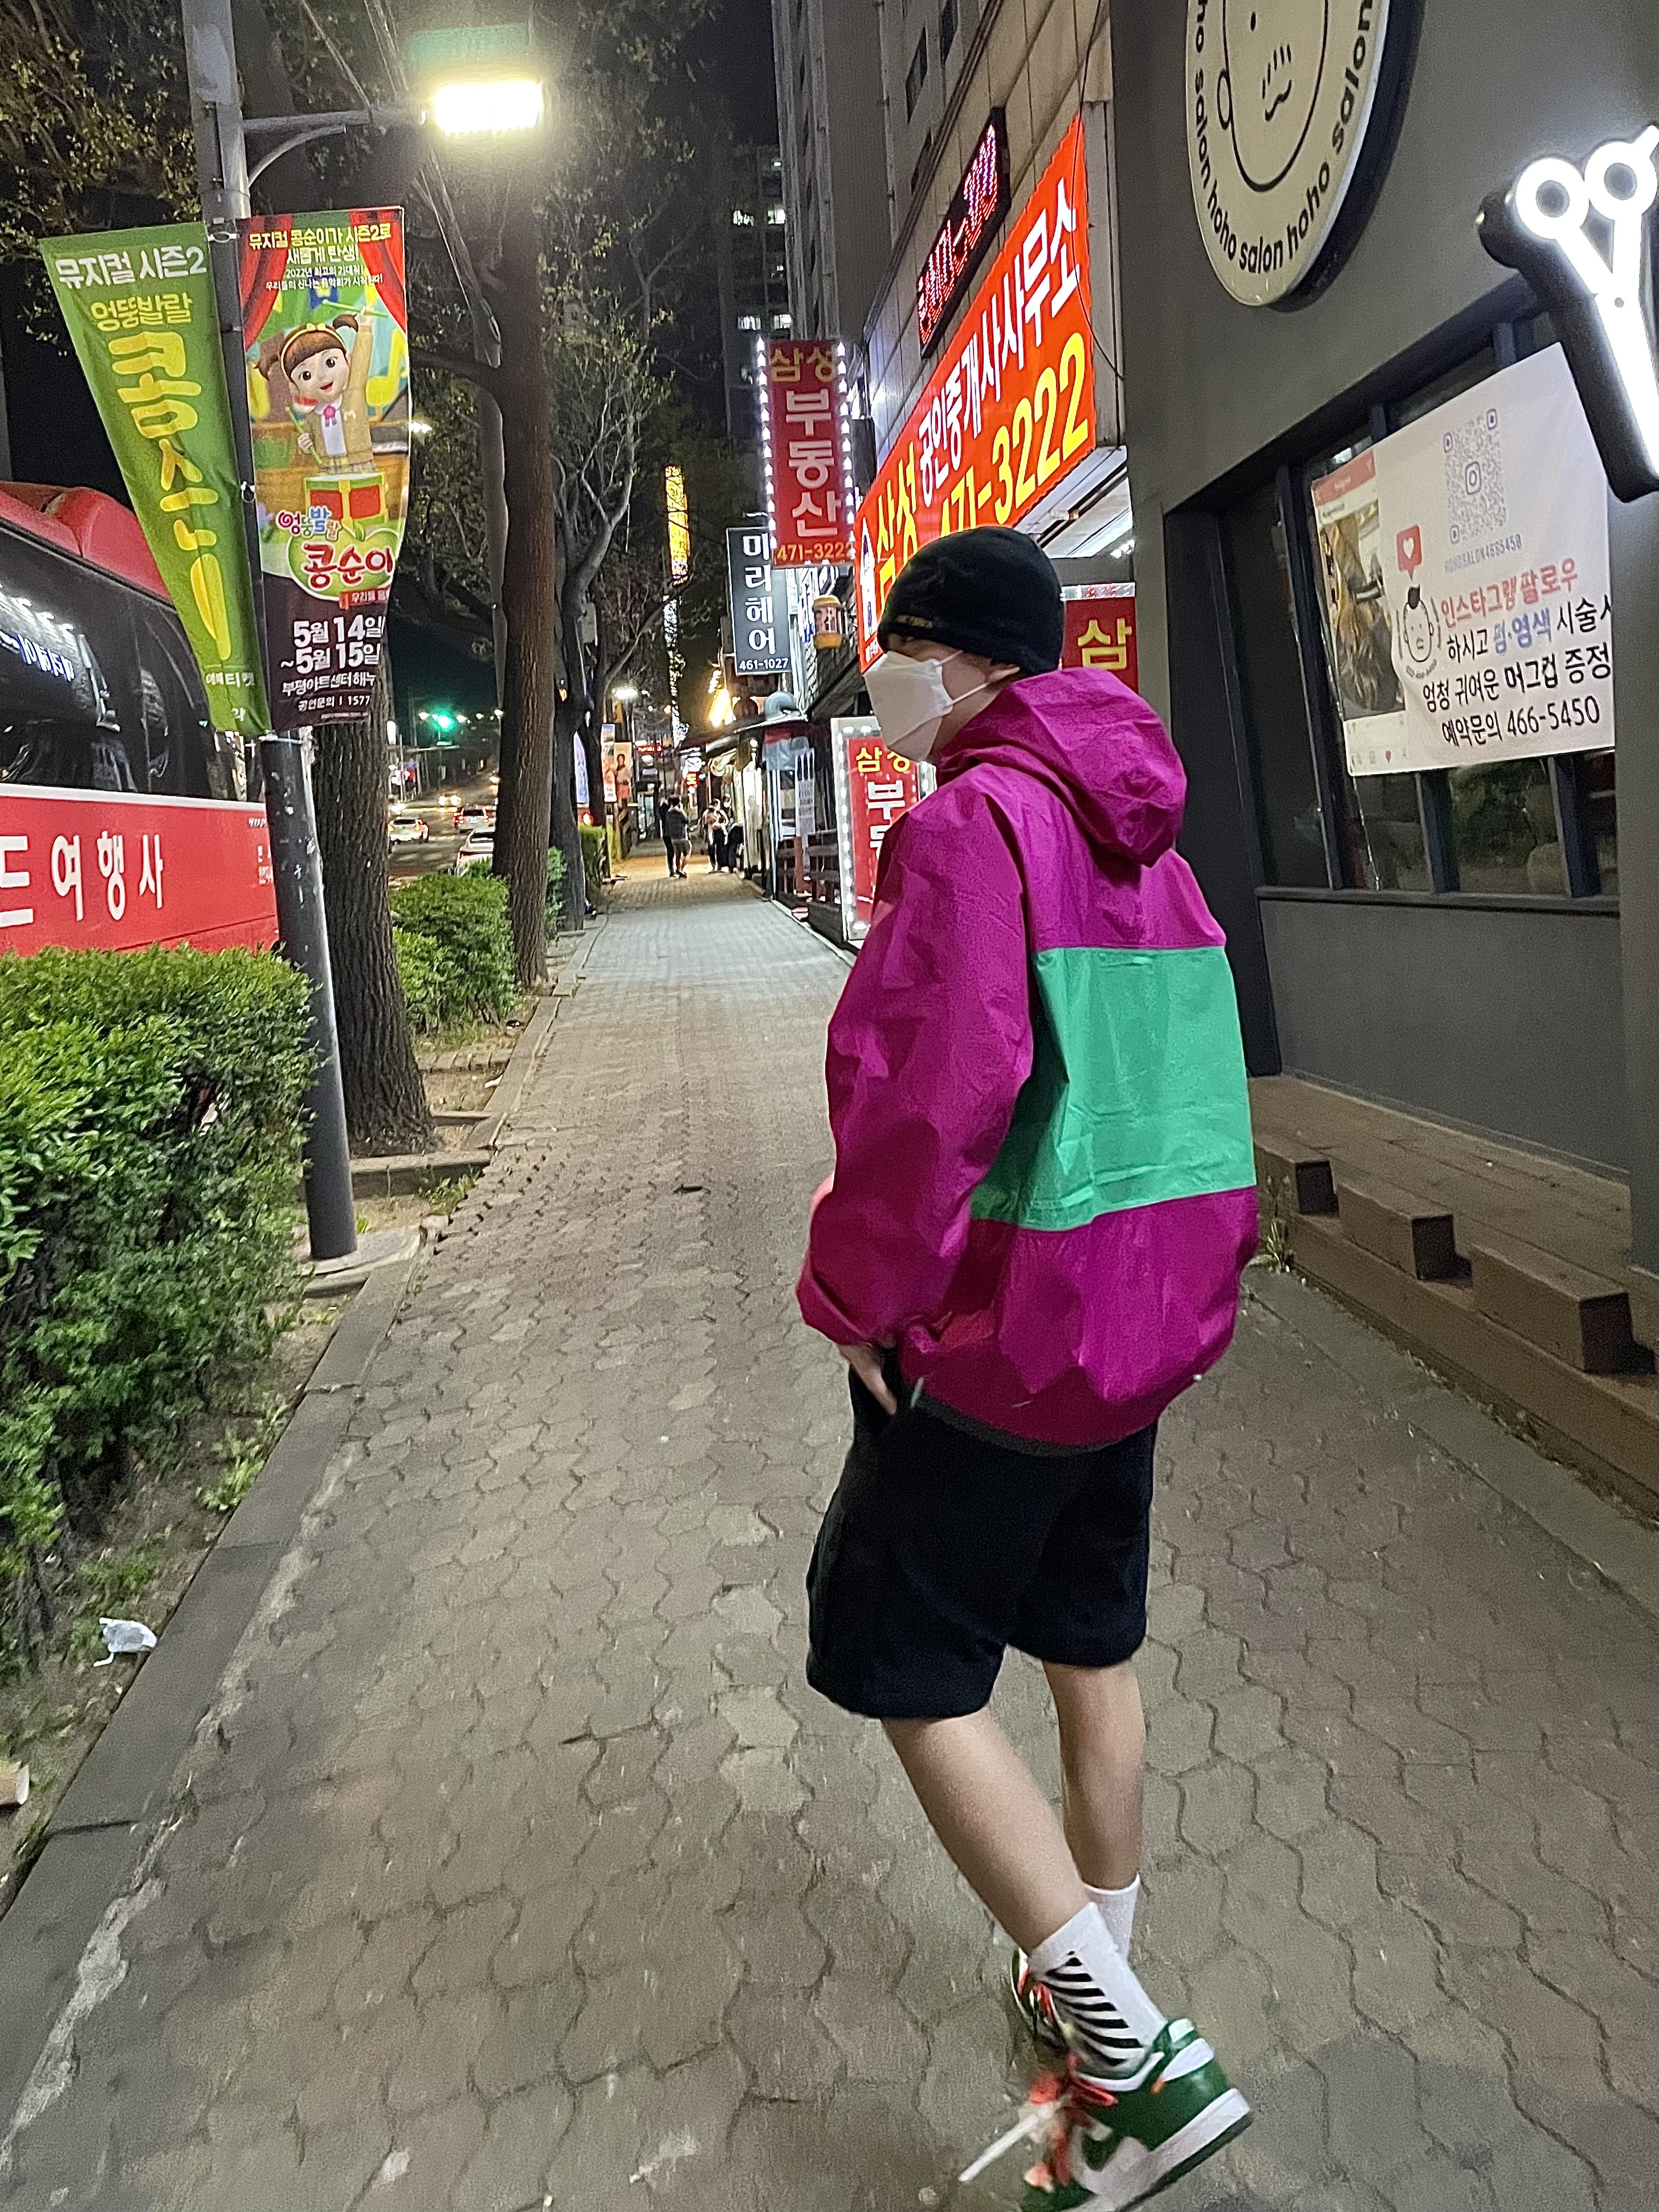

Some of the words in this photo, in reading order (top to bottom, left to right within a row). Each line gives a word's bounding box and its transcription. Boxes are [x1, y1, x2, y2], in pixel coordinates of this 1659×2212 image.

[1195, 68, 1210, 189] salon
[1207, 179, 1237, 261] hoho
[1238, 236, 1283, 274] salon
[1287, 162, 1330, 259] hoho
[249, 230, 288, 250] 뮤지컬
[291, 227, 343, 247] 콩순이가
[345, 223, 392, 243] 시즌2로
[286, 246, 325, 266] 새롭게
[55, 250, 136, 289] 뮤지컬
[140, 246, 207, 279] 시즌2
[90, 292, 193, 332] 엉뚱발랄
[770, 346, 837, 382] 삼성
[918, 177, 1080, 509] 공인중개사사무소
[786, 389, 842, 537] 부동산
[109, 330, 231, 660] 콩순이
[303, 542, 393, 589] 콩순이
[742, 533, 776, 655] 미리헤어
[1441, 577, 1517, 628] 인스타그램
[1521, 557, 1578, 605] 팔로우
[294, 620, 329, 648] 5월
[333, 614, 382, 643] 14일
[1077, 617, 1132, 670] 삼
[1446, 628, 1489, 664] 하시고
[1557, 595, 1597, 636] 시술
[335, 640, 381, 670] 15일
[739, 658, 789, 671] 461-1027
[1422, 678, 1450, 712] 엄청
[1455, 668, 1500, 707] 귀여운
[1504, 652, 1559, 693] 머그컵
[1565, 641, 1612, 684] 증정
[348, 695, 370, 706] 1577
[1441, 709, 1503, 748] 예약문의
[1507, 695, 1601, 737] 466-5450
